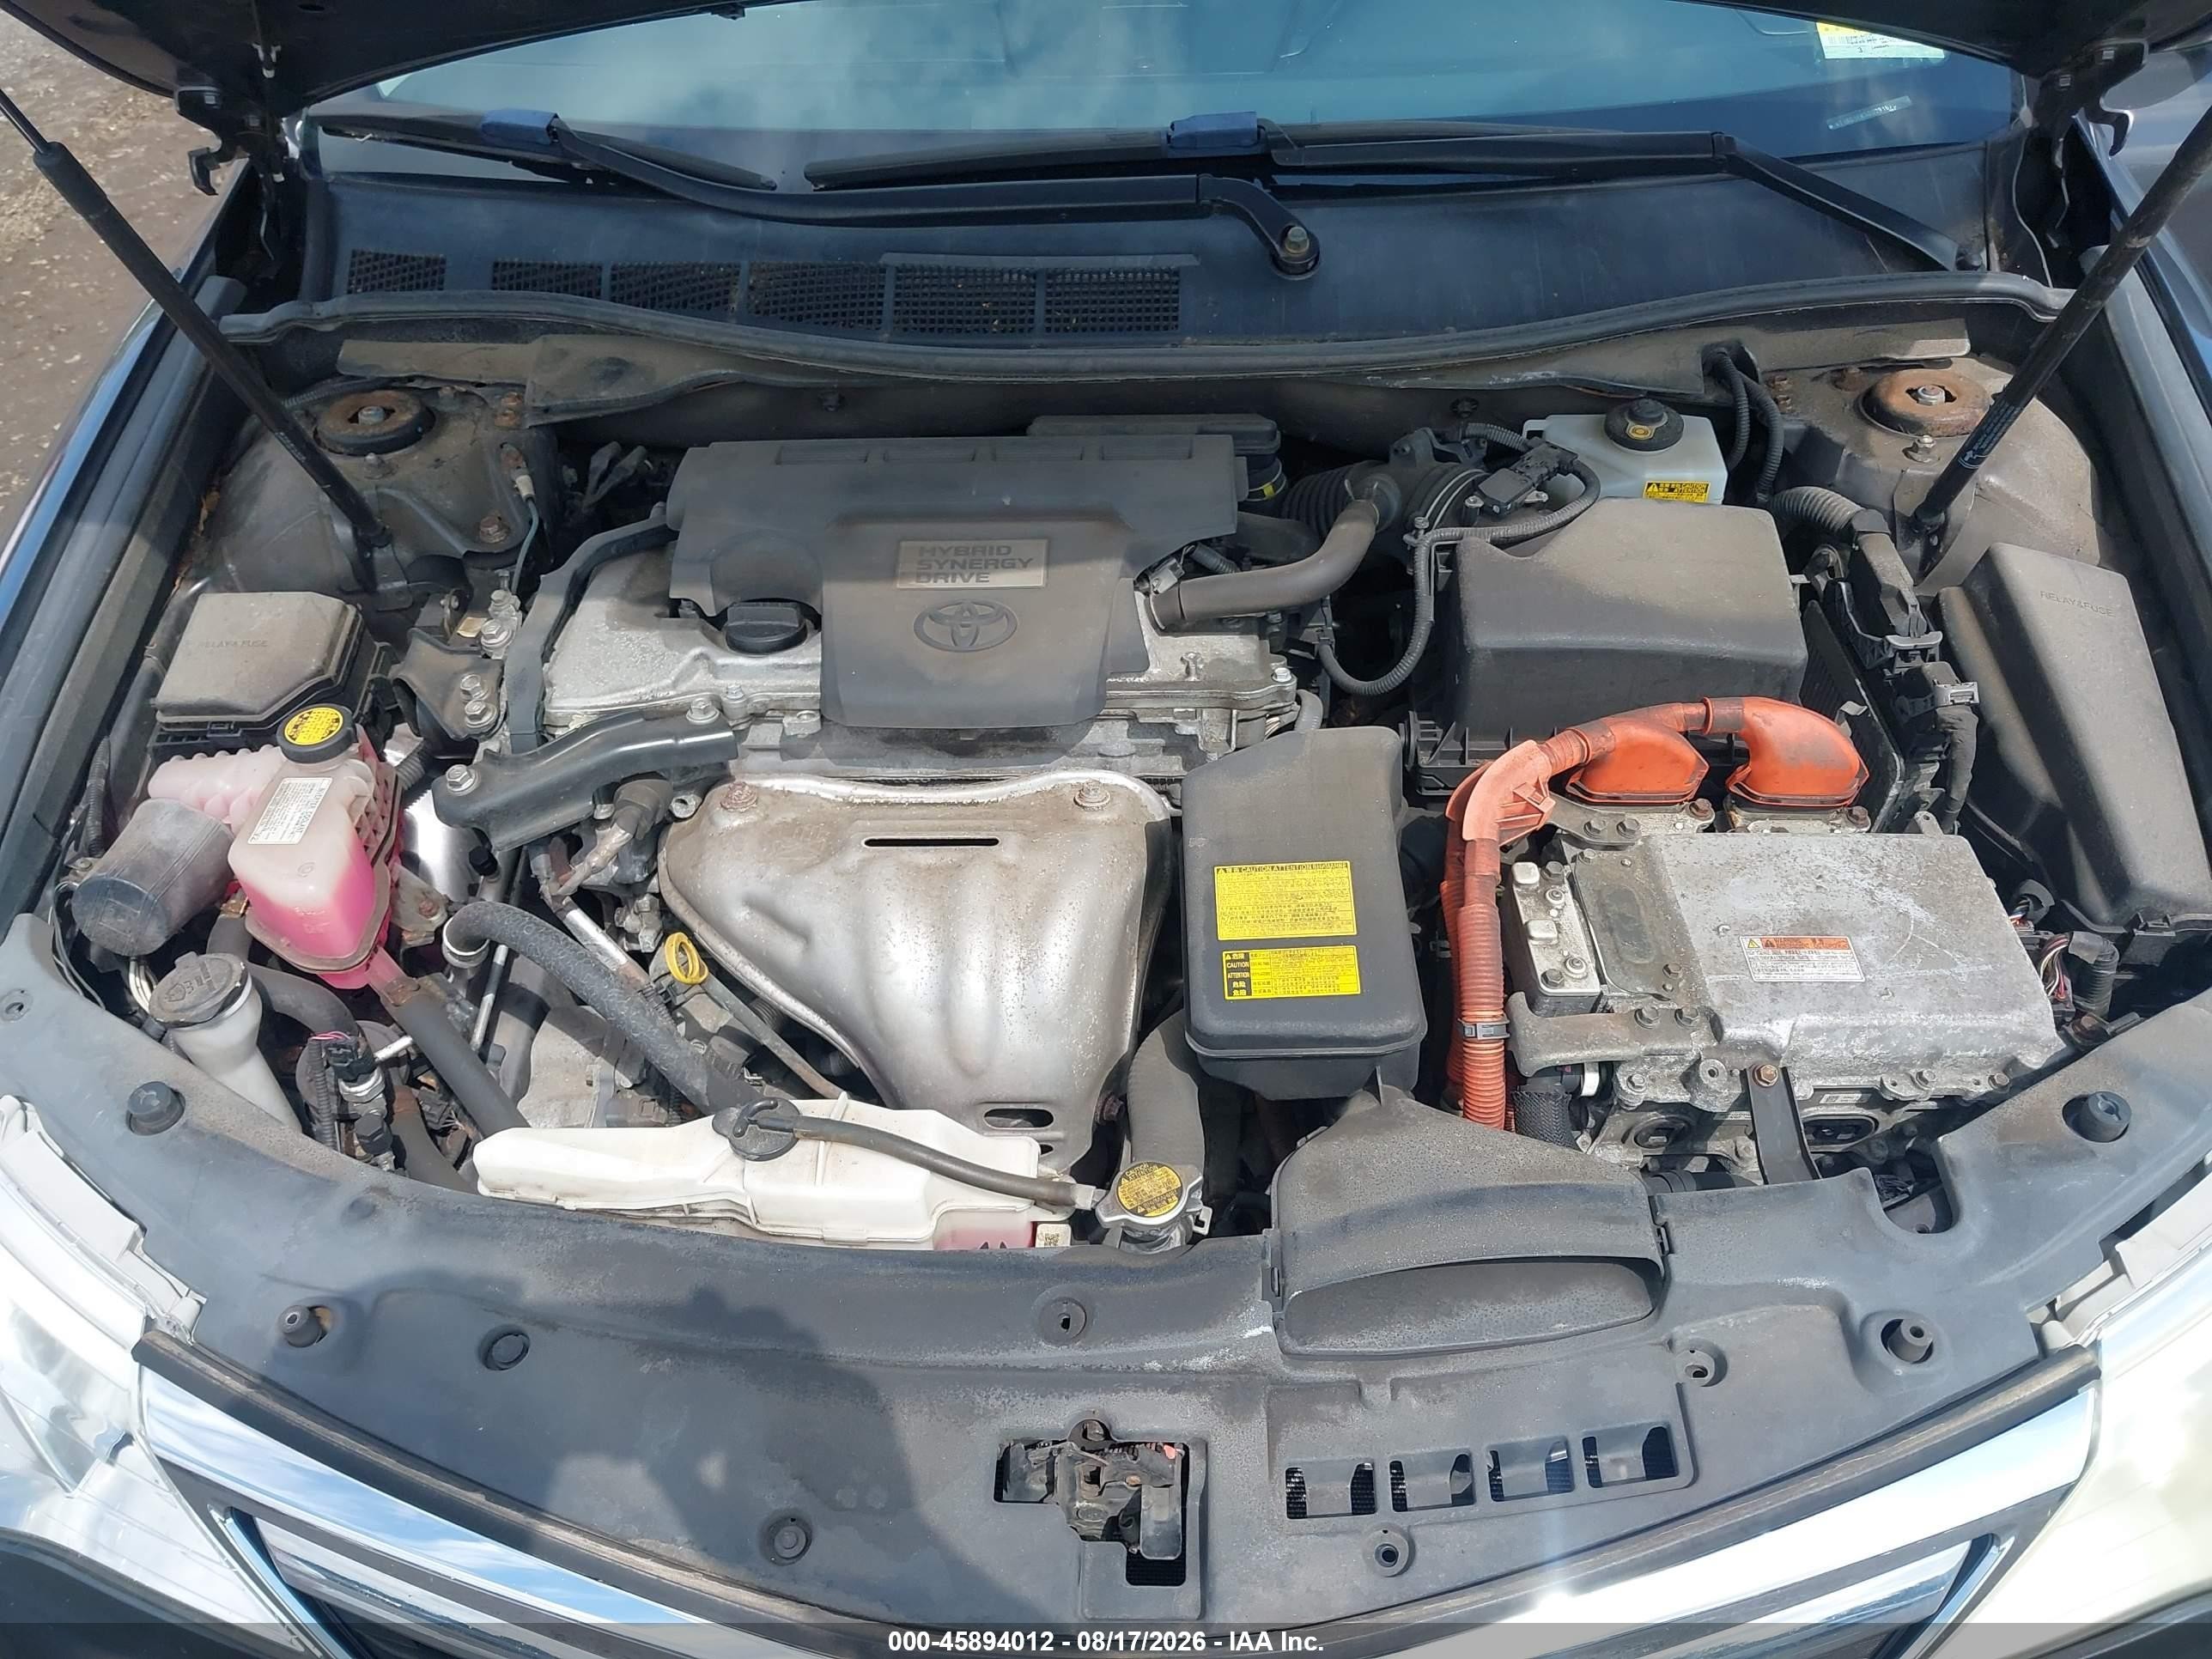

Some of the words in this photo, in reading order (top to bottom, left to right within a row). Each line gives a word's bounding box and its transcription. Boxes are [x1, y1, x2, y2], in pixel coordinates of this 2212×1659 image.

[919, 545, 1012, 556] HYBRID
[917, 558, 1033, 570] SYNERGY
[915, 572, 990, 584] DRIVE
